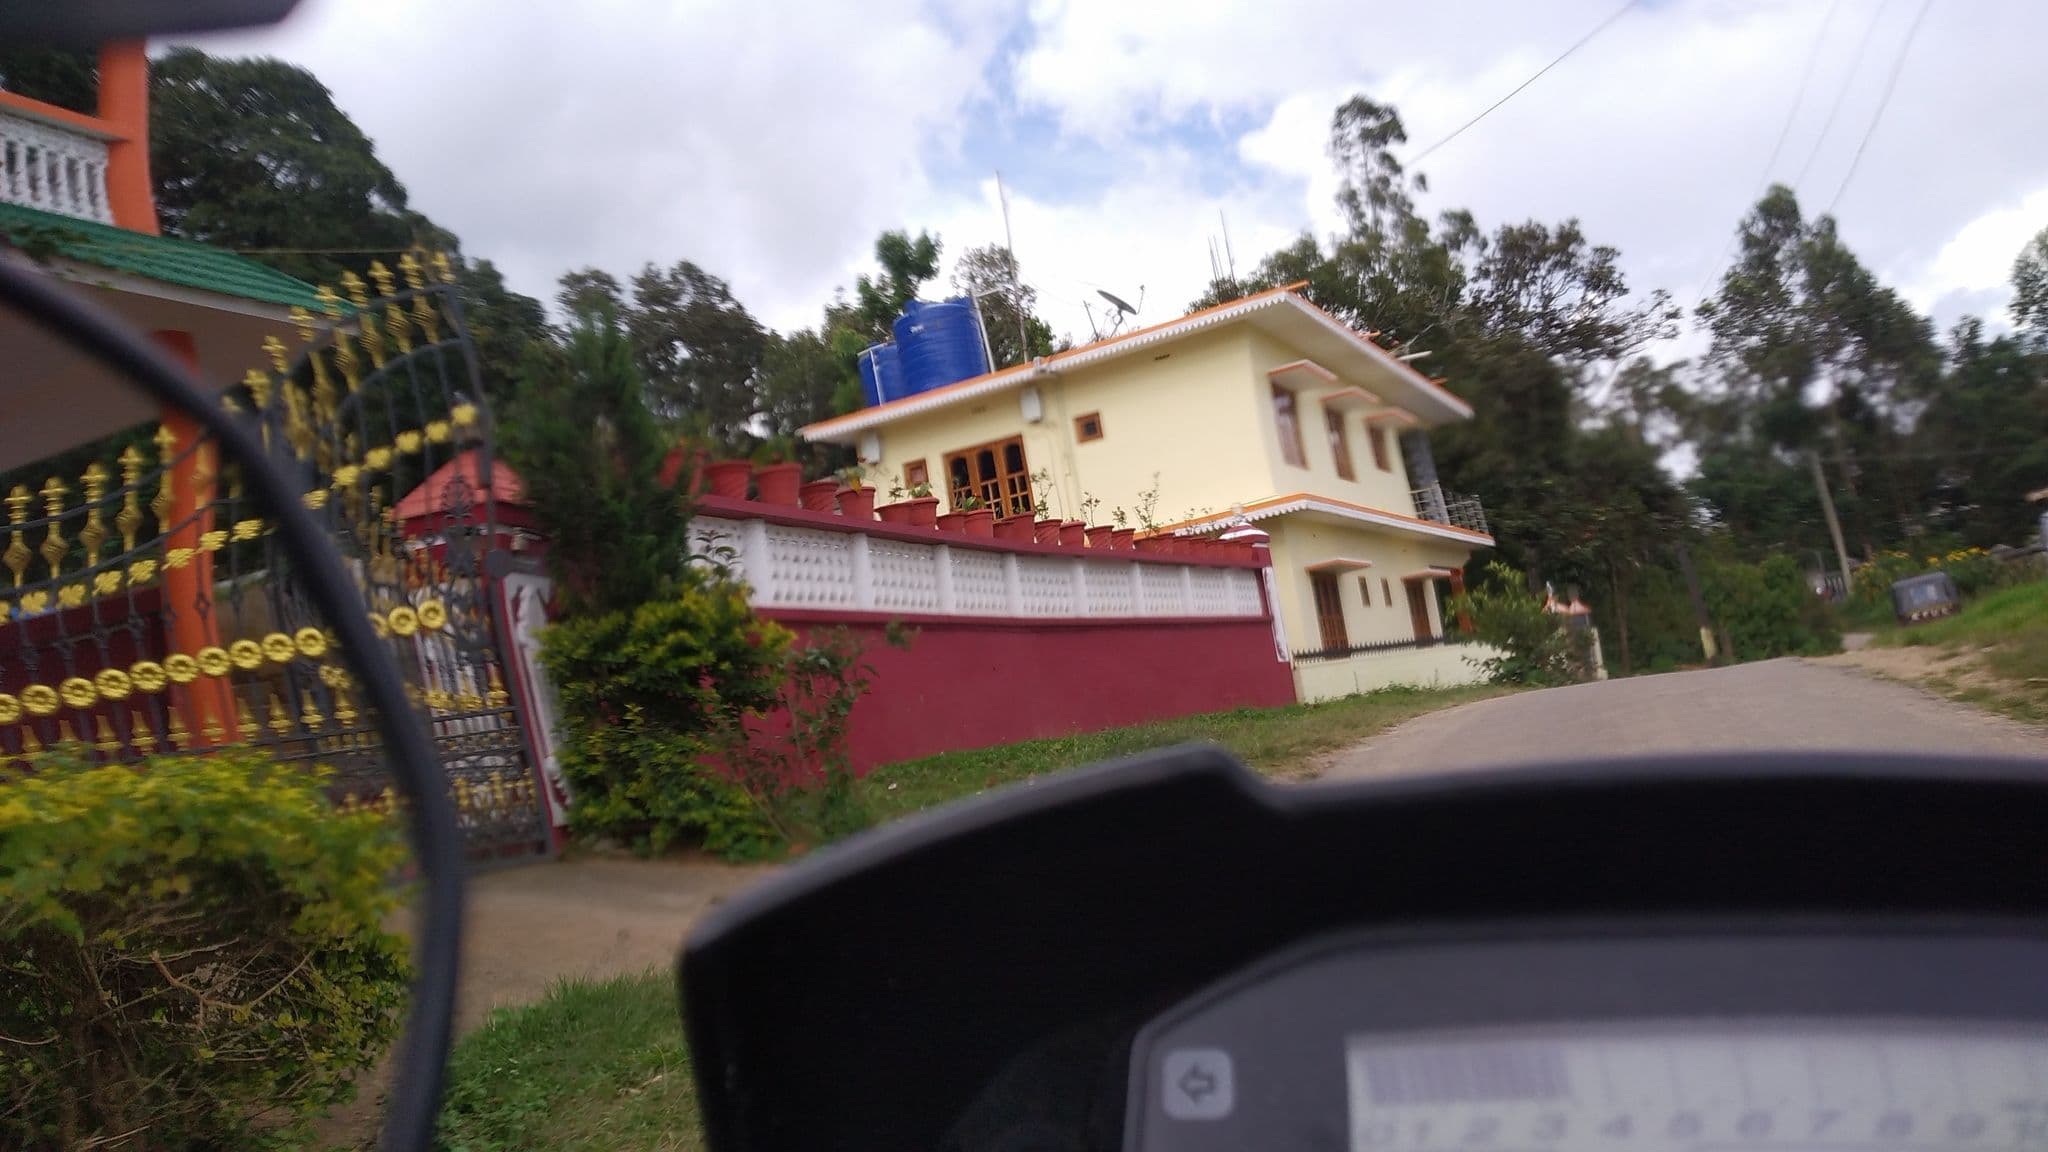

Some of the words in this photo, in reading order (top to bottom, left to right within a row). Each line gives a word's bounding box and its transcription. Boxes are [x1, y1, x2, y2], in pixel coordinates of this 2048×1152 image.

[1460, 1115, 1501, 1145] 2
[1532, 1112, 1569, 1142] 3
[1599, 1112, 1635, 1140] 4
[1810, 1108, 1843, 1137] 7
